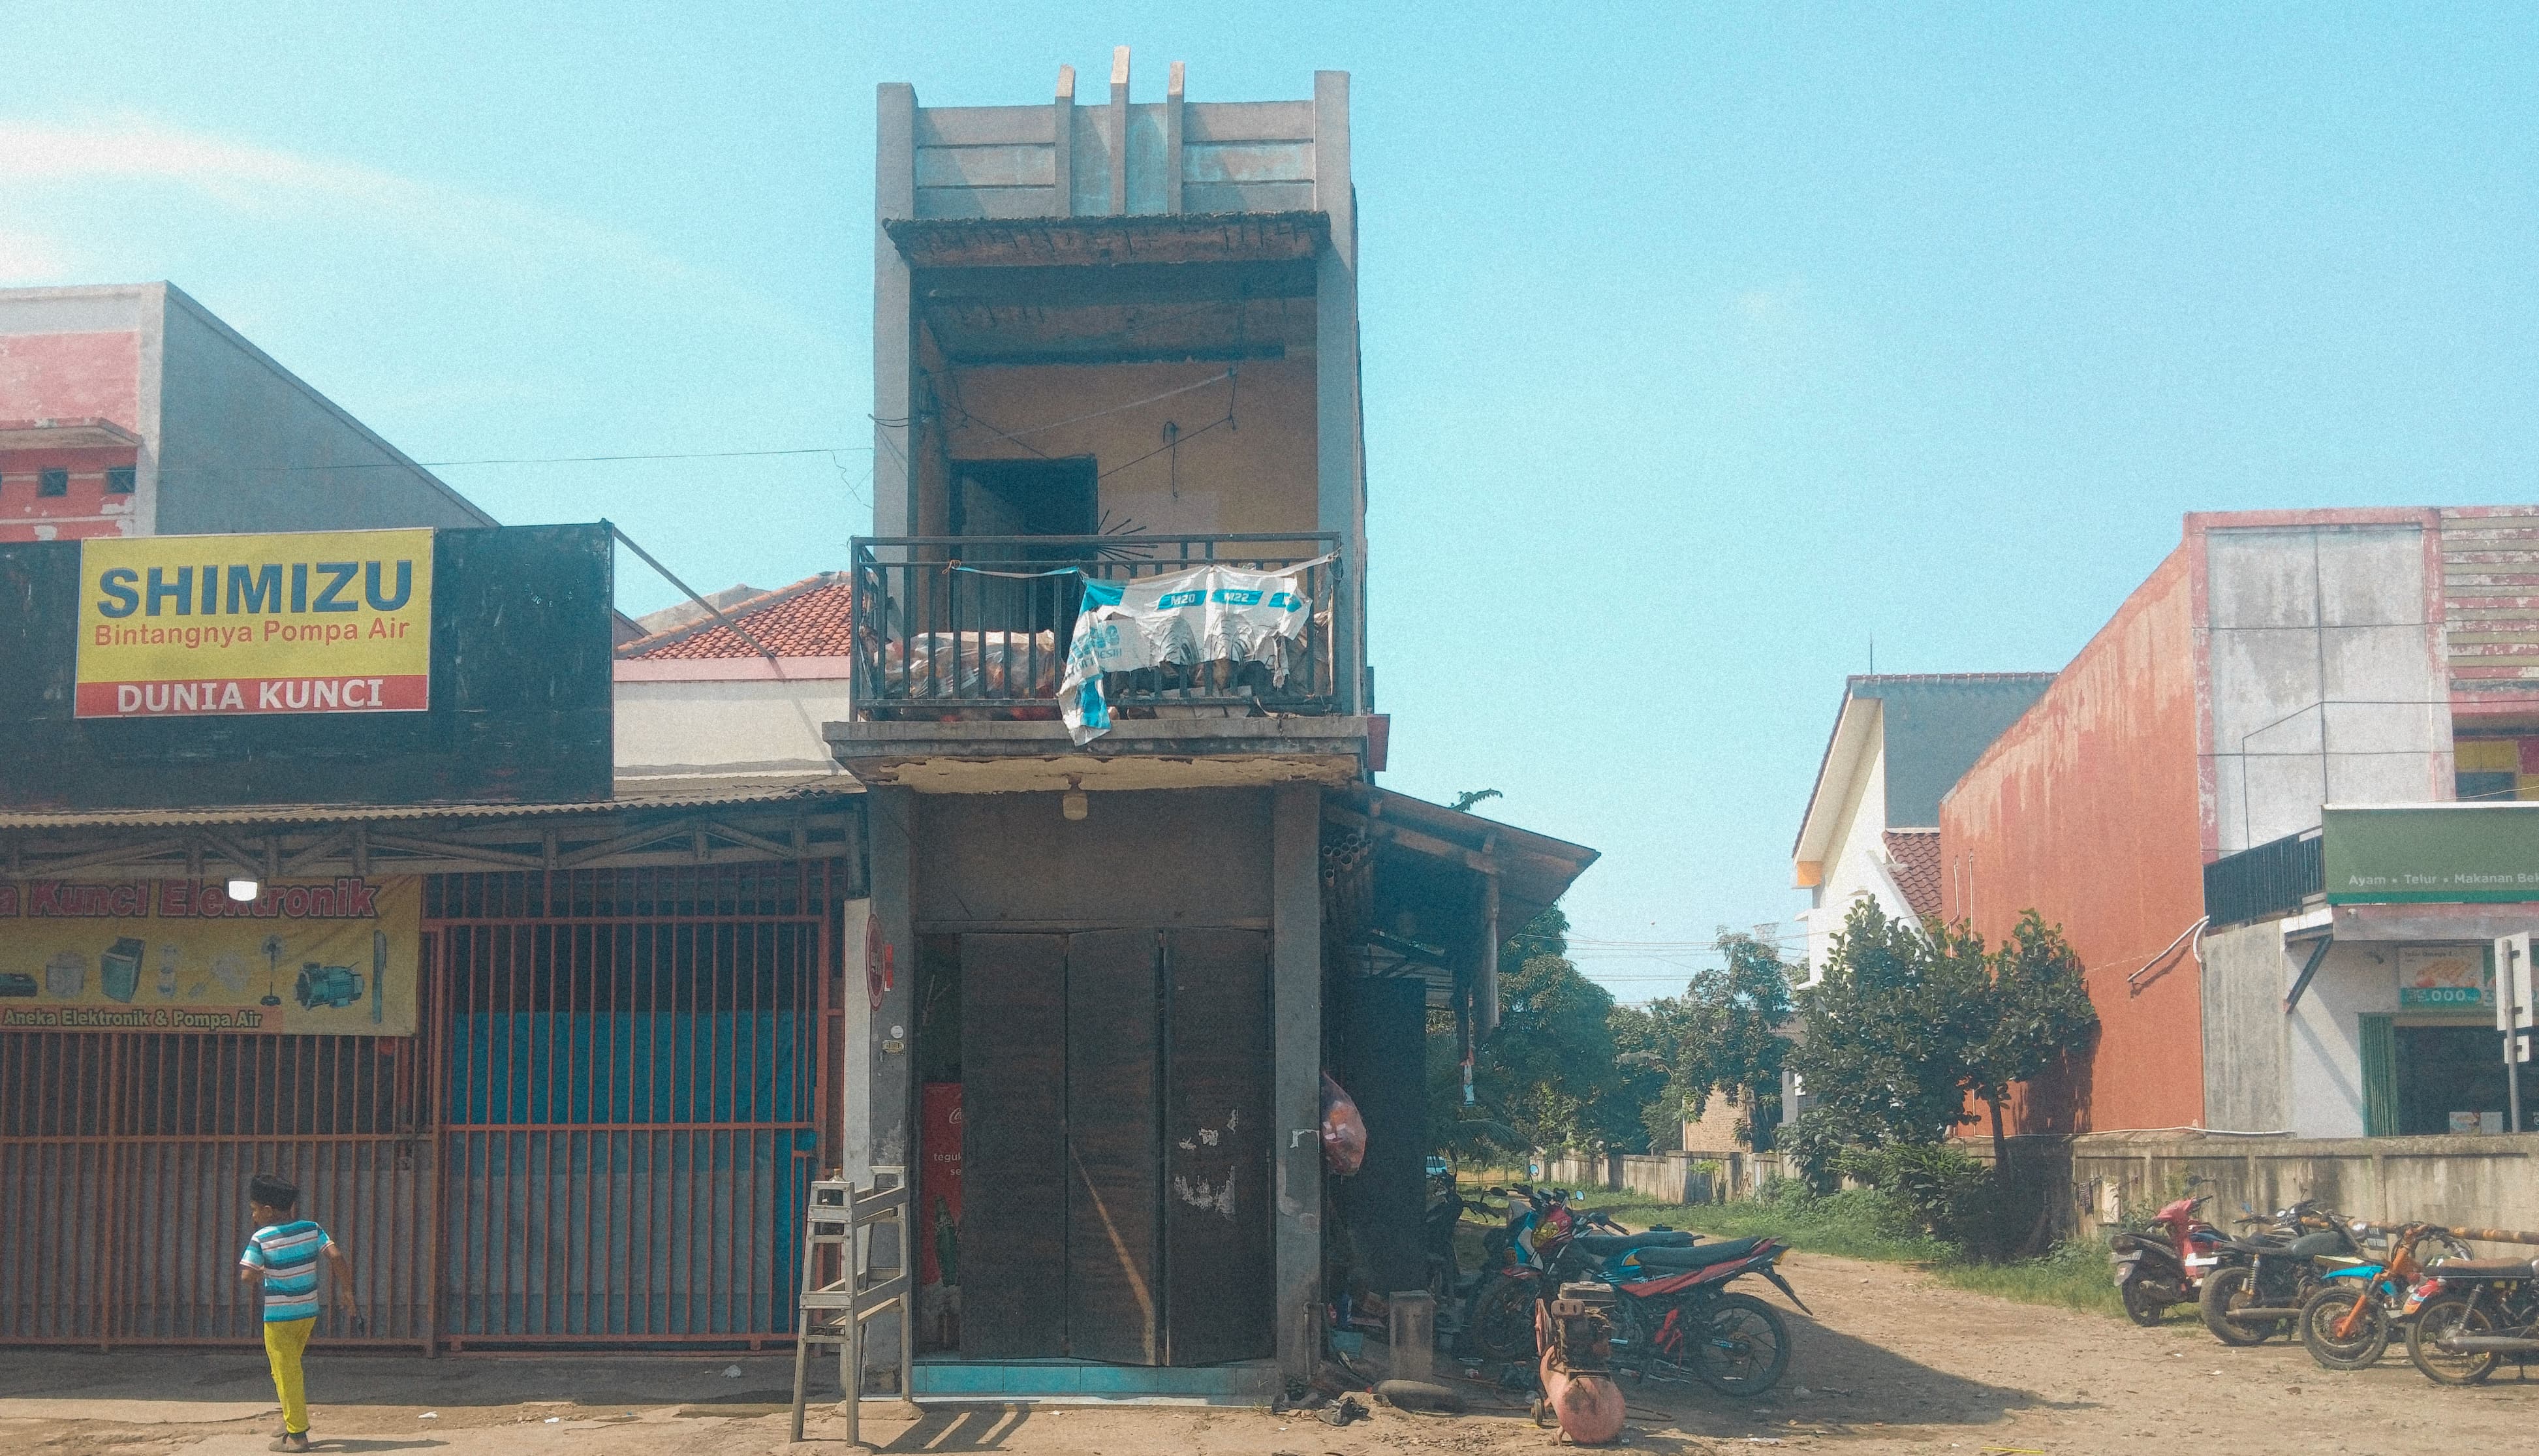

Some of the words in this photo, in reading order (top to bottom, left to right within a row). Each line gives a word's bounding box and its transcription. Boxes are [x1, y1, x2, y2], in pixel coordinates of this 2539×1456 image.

[97, 560, 412, 619] SHIMIZU
[1170, 593, 1196, 605] M20
[1224, 592, 1249, 602] M22
[95, 625, 252, 649] Bintangnya
[264, 620, 358, 646] Pompa
[368, 617, 411, 640] Air
[117, 682, 245, 713] DUNIA
[258, 679, 384, 709] KUNCI
[2348, 875, 2386, 886] Ayam
[2404, 874, 2437, 884] Telur
[2455, 873, 2513, 884] Makanan
[31, 878, 149, 916] Kunci
[3, 1009, 57, 1027] Aneka
[61, 1010, 149, 1027] Elektronik
[154, 1010, 168, 1027] &
[173, 1010, 233, 1030] Pompa
[236, 1011, 262, 1027] Air
